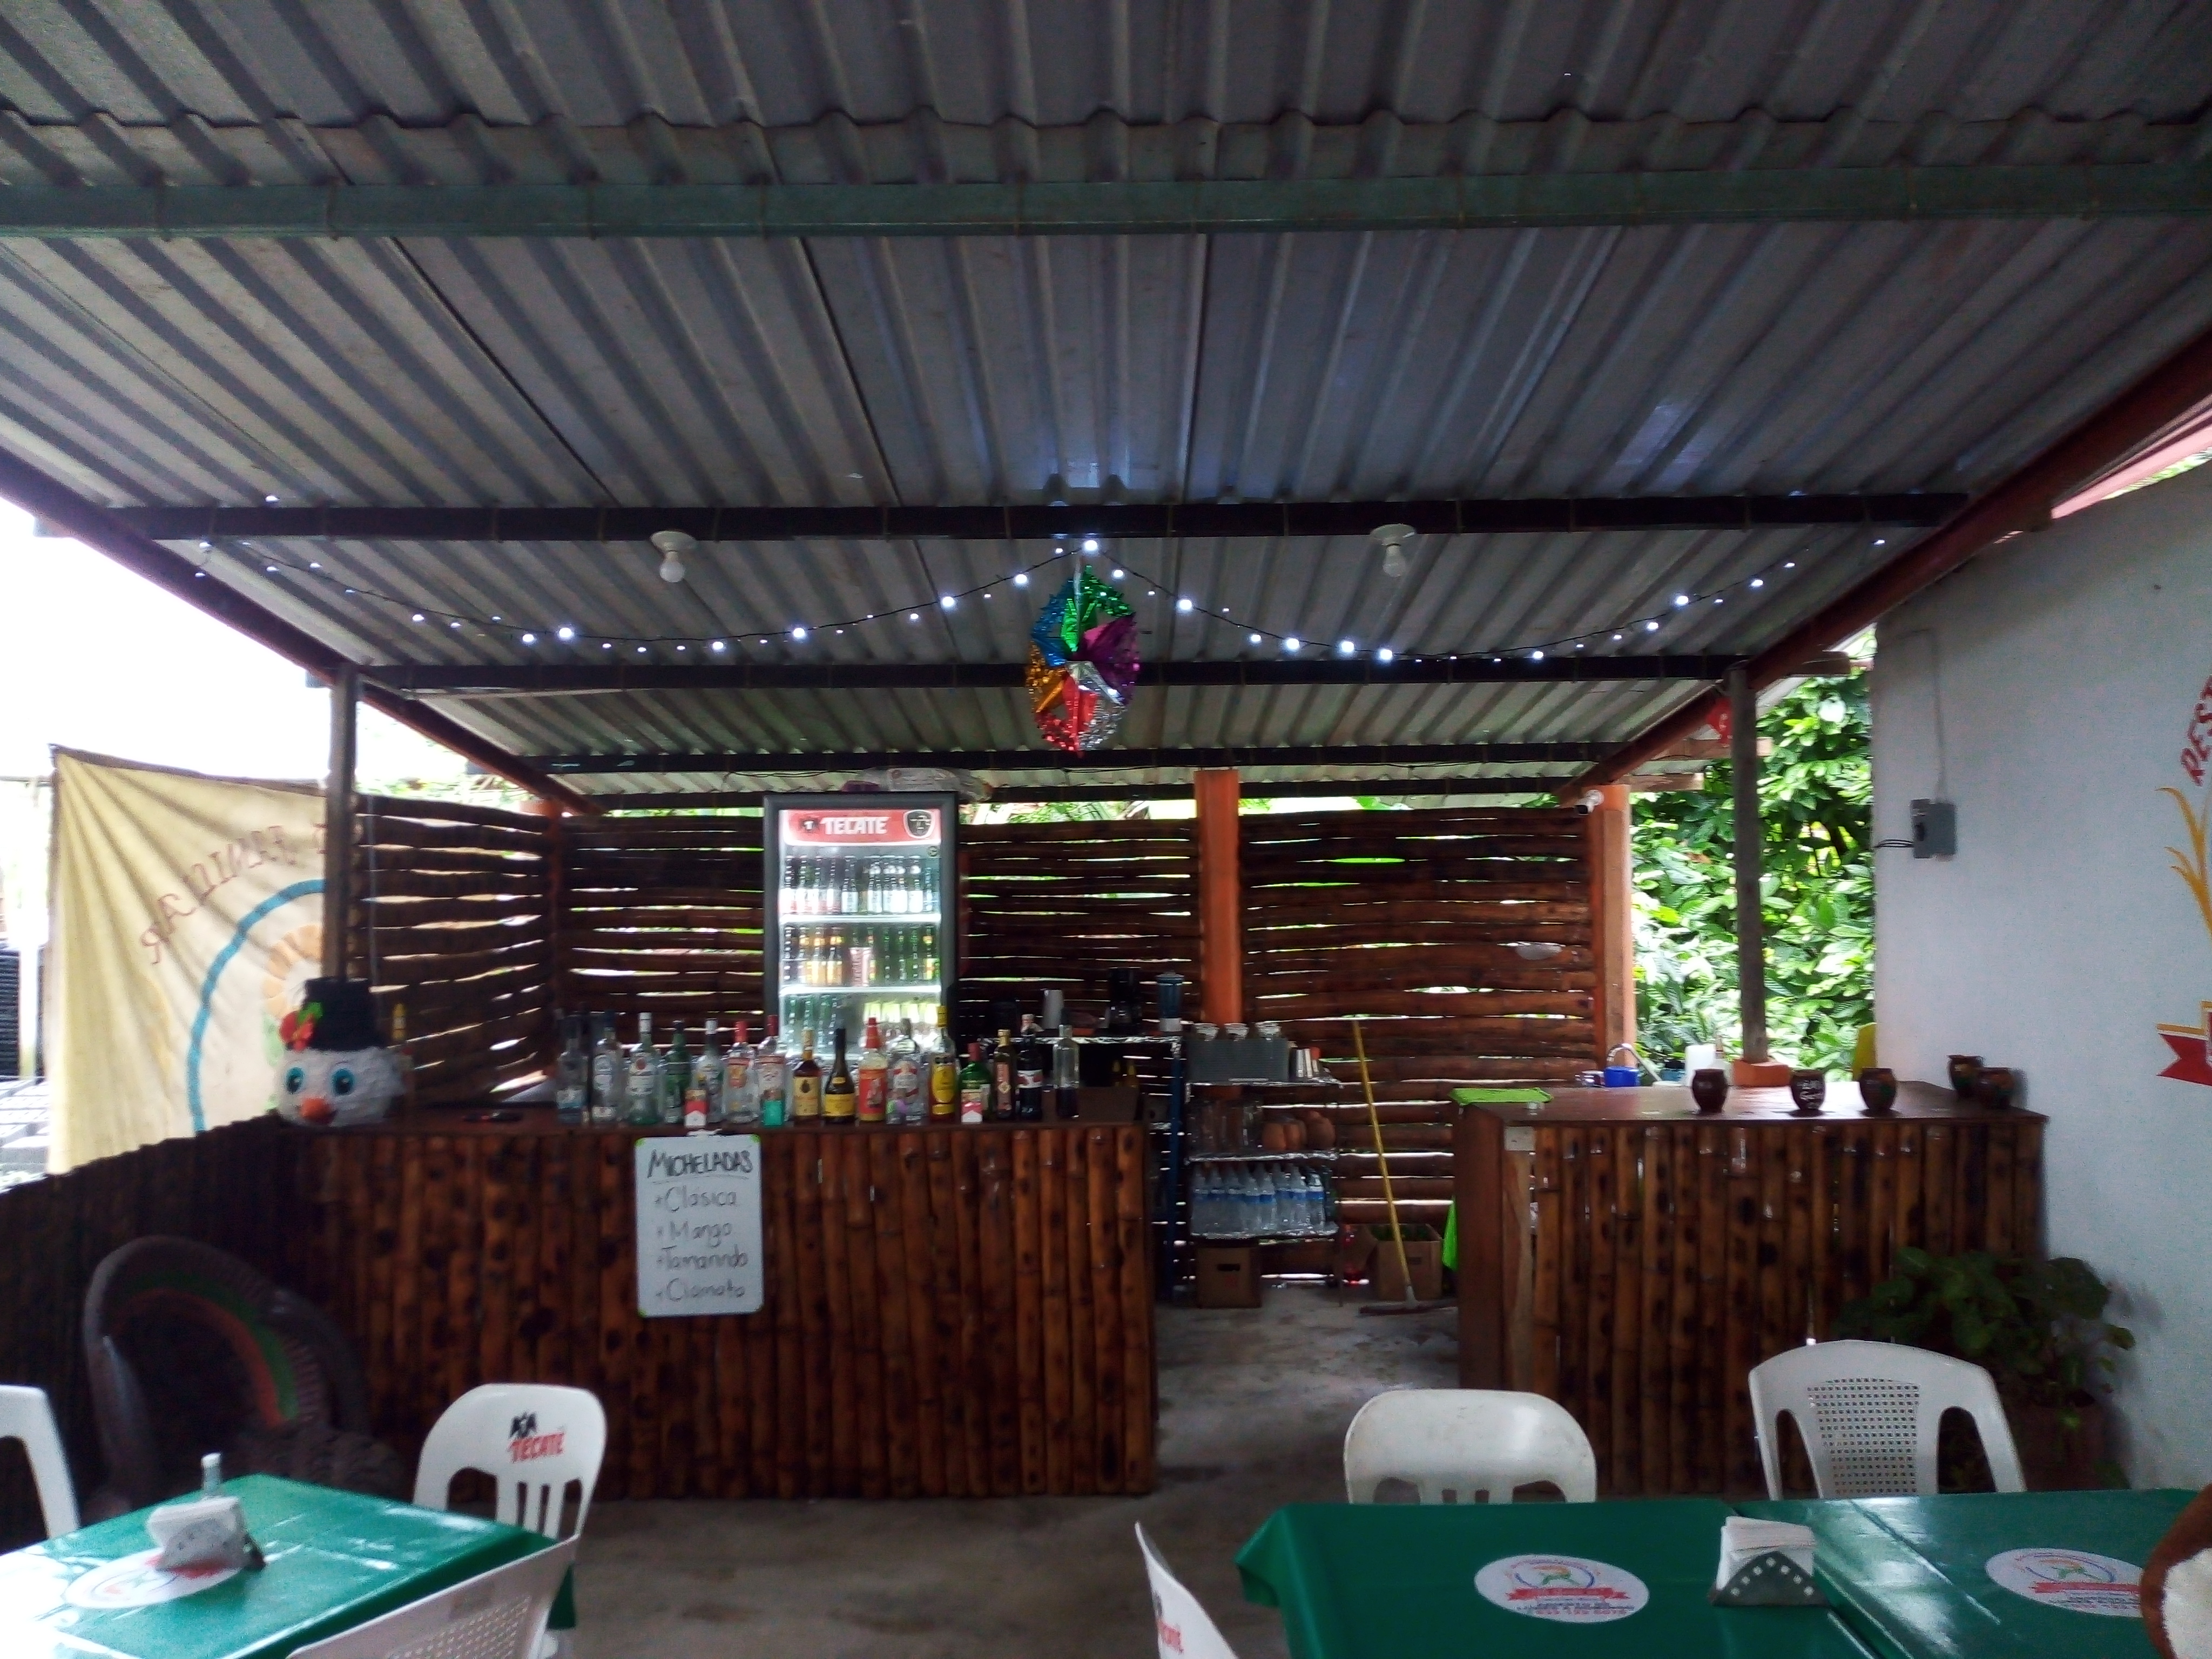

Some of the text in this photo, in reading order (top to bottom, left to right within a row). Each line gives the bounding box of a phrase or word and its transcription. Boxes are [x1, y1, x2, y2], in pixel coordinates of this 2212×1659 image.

[819, 816, 892, 835] TECATE
[647, 1149, 753, 1178] MICHELADAS
[670, 1219, 732, 1248] Mango
